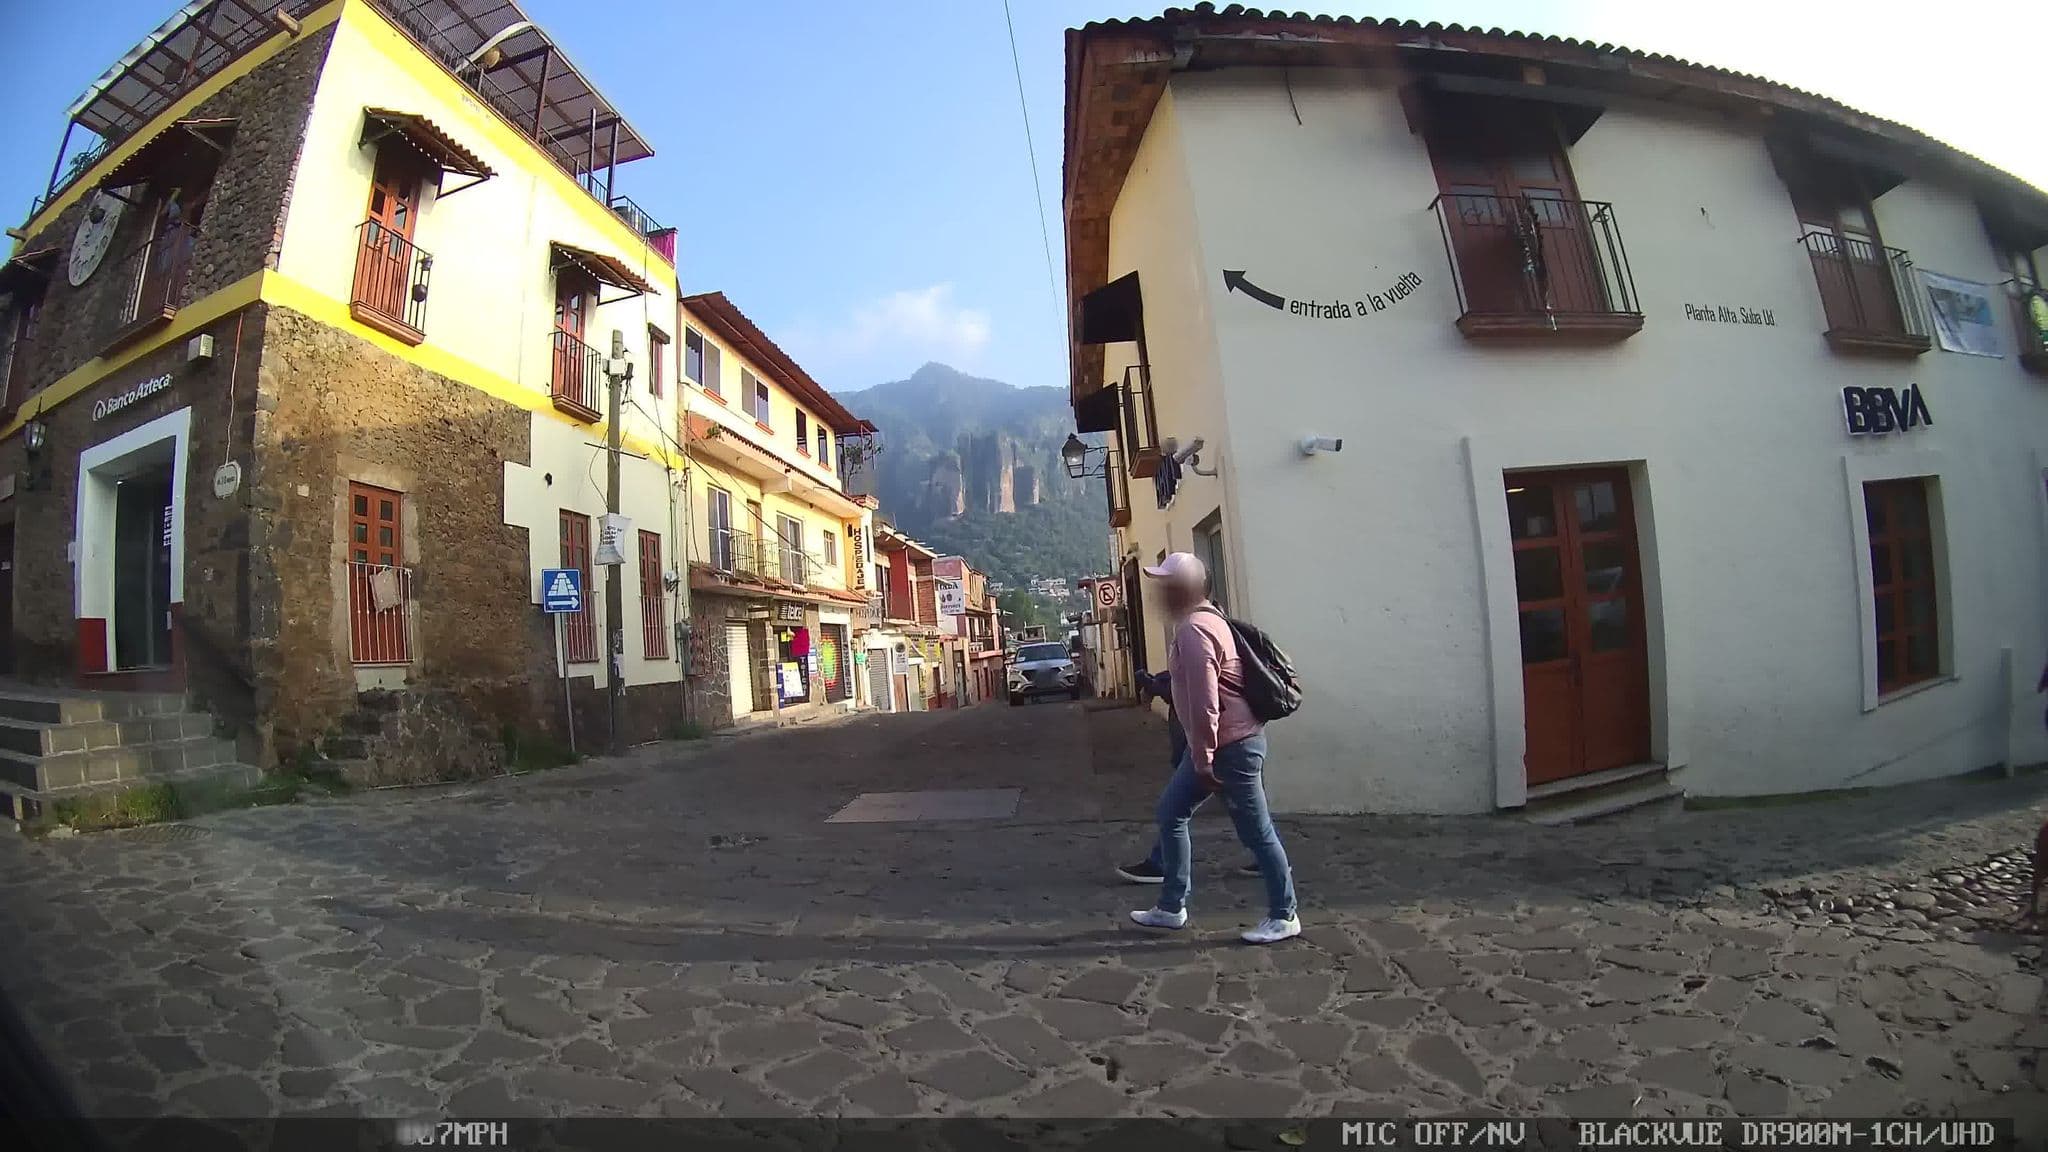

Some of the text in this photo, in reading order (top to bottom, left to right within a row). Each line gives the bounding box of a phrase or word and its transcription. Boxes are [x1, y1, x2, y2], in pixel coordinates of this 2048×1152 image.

[1290, 271, 1423, 319] entrada a la vuelta
[1685, 303, 1716, 322] Planta
[1740, 306, 1762, 325] Suba
[106, 373, 171, 415] Banco Azteca
[1842, 383, 1933, 435] BBVA
[853, 527, 865, 586] HOSPEDAJE
